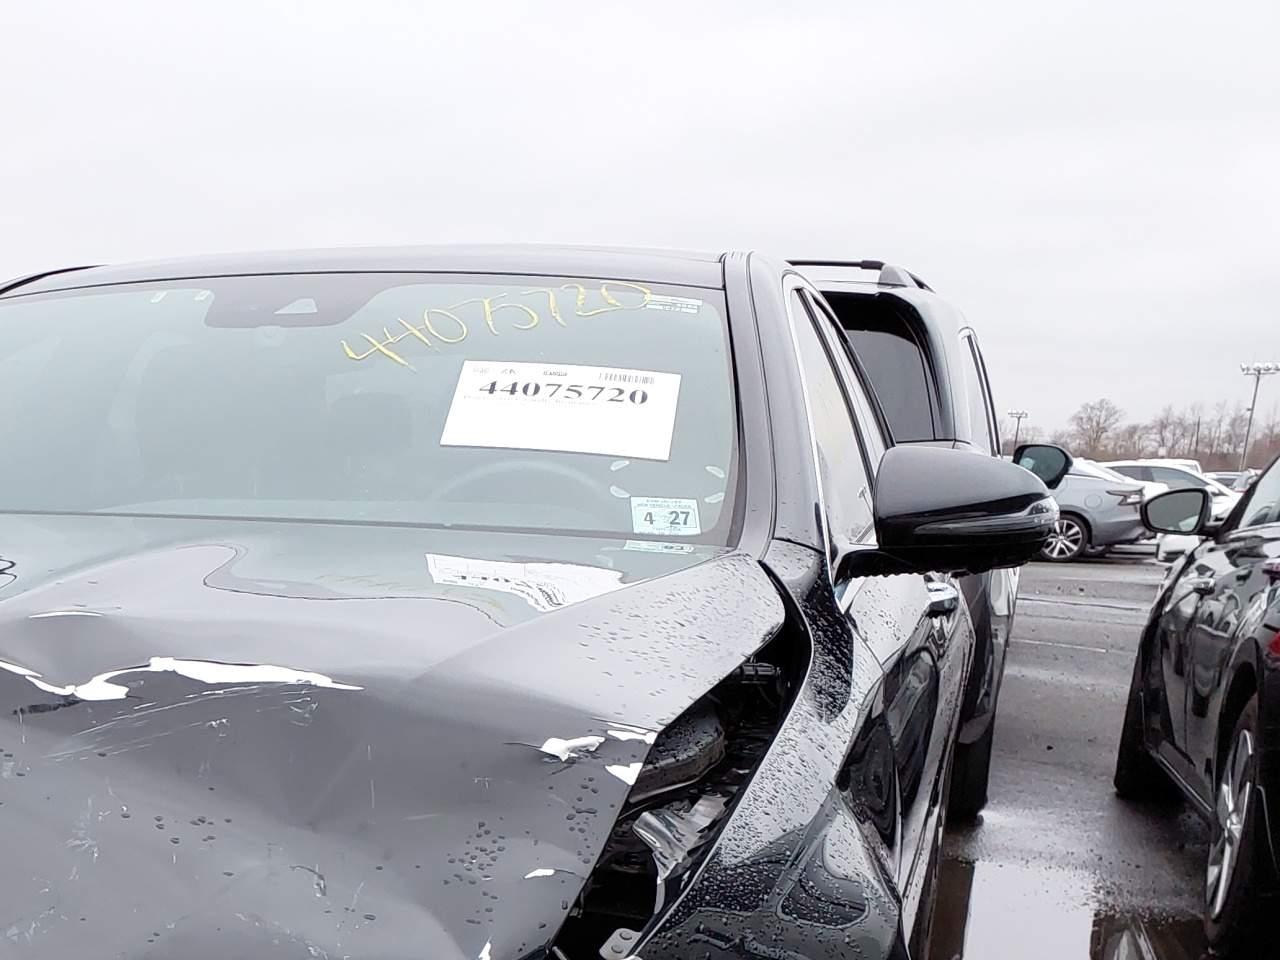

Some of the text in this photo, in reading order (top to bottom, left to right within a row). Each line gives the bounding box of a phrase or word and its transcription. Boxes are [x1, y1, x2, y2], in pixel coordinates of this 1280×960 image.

[340, 280, 652, 367] 44075720
[478, 380, 649, 405] 44075720
[643, 510, 691, 526] 4 27
